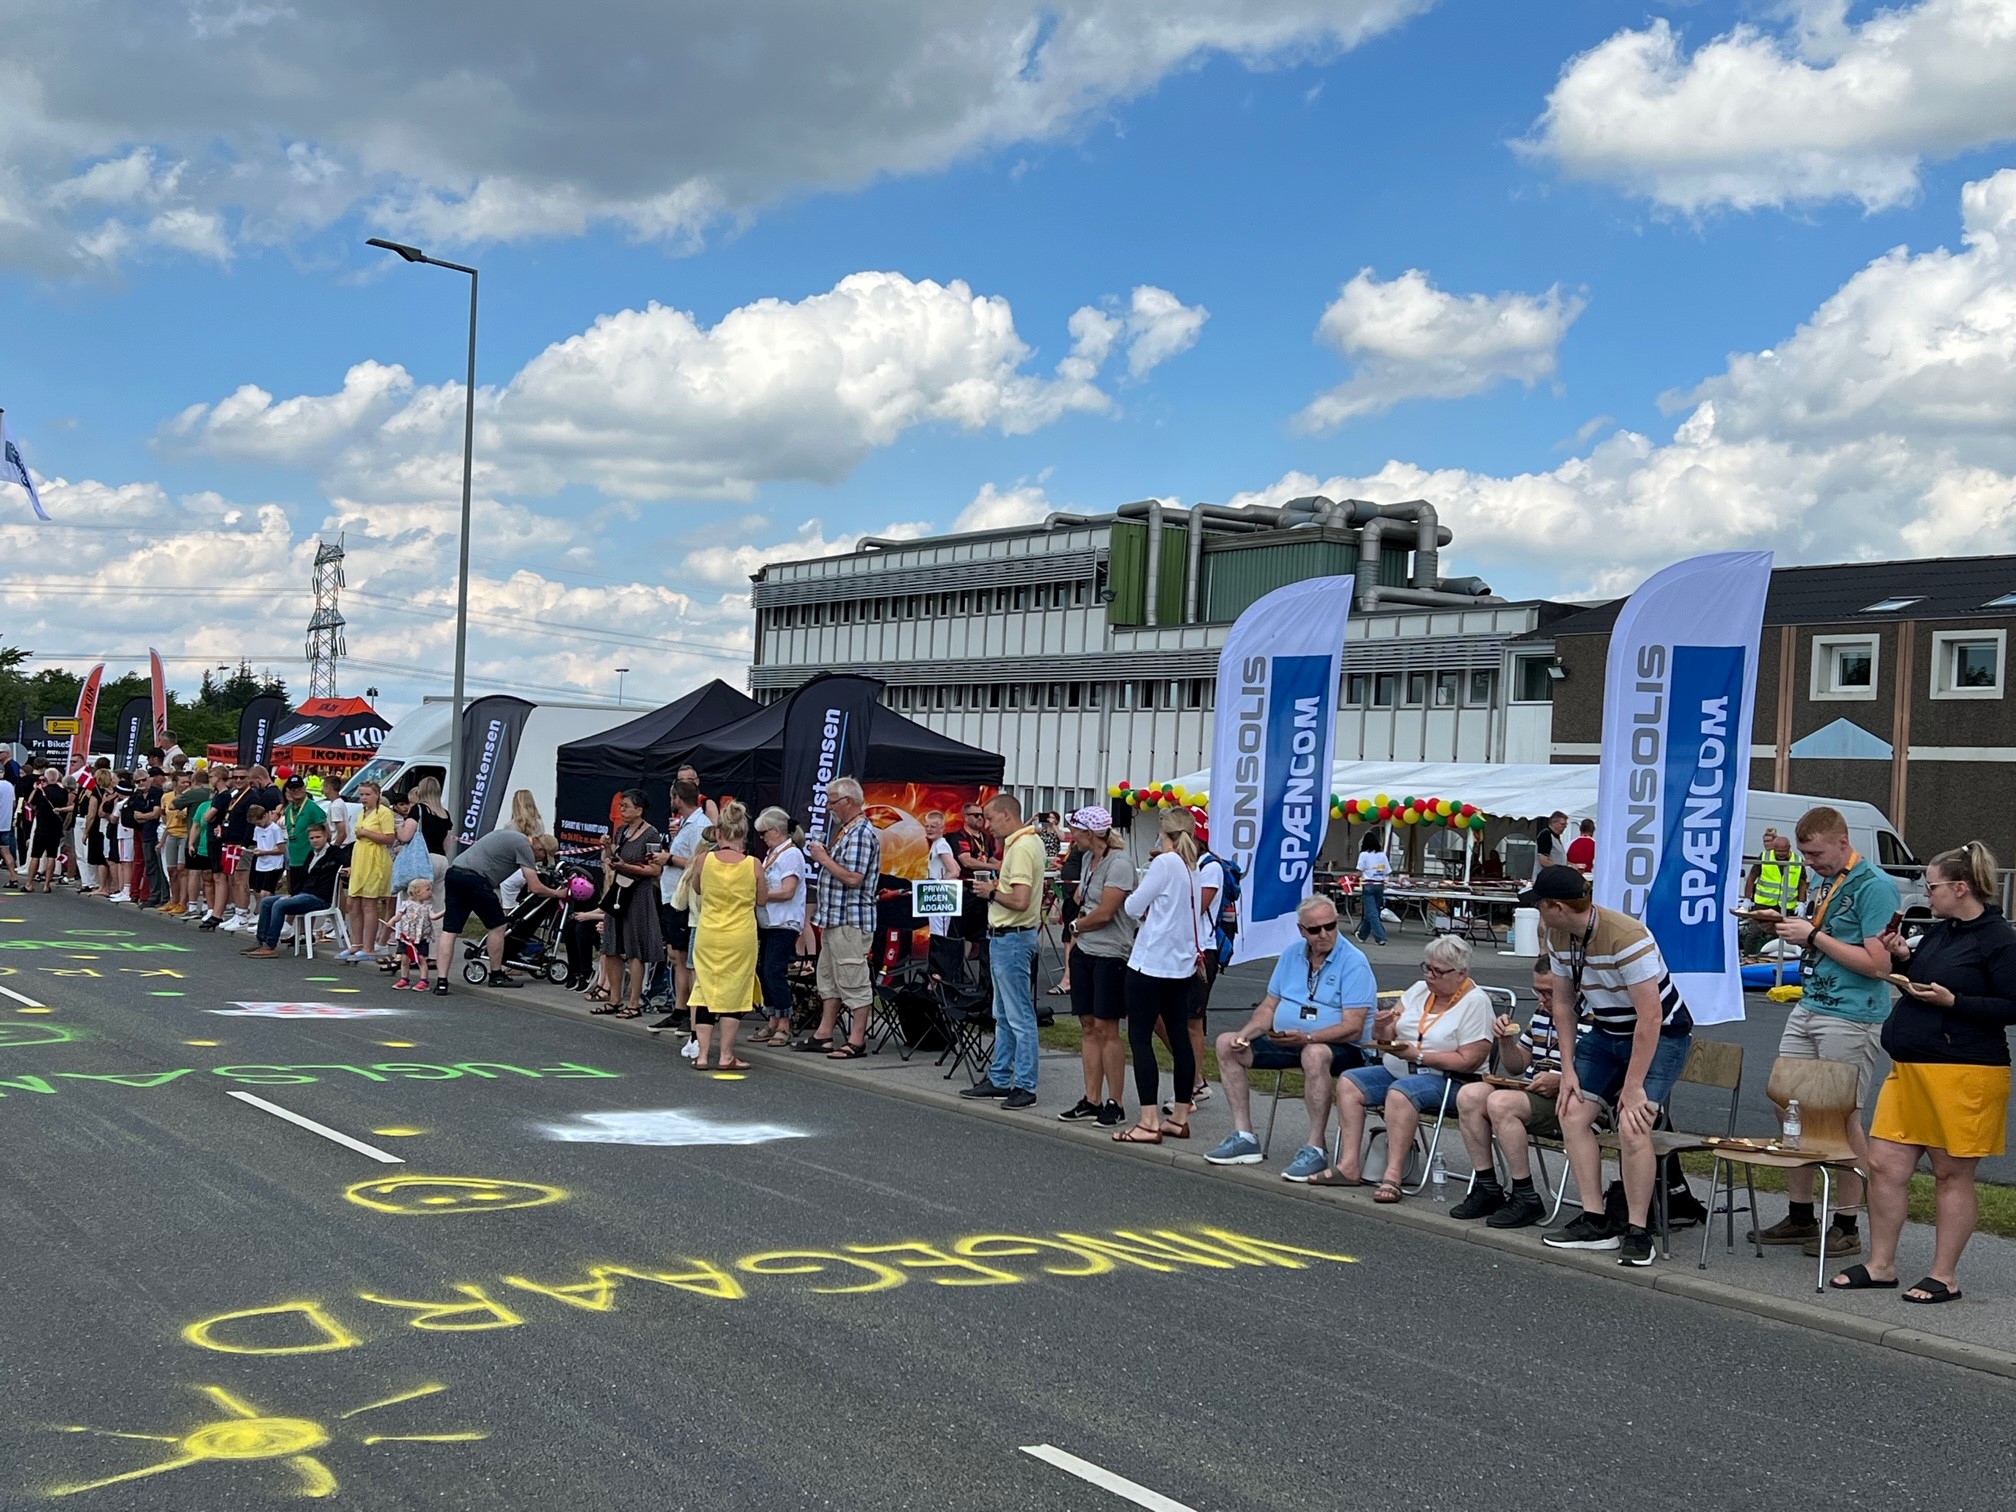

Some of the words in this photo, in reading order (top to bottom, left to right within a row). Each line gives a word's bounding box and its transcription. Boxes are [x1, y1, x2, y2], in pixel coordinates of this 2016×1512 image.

[47, 740, 71, 748] BikeS
[345, 727, 390, 746] IKO
[464, 720, 501, 829] Christensen
[1232, 656, 1267, 880] CONSOLIS
[1279, 696, 1320, 883] SPÆNCOM
[1623, 644, 1666, 921] CONSOLIS
[1679, 695, 1729, 926] SPÆNCOM
[920, 904, 954, 912] ADGANG
[182, 1226, 1360, 1354] VINGEGAARD
